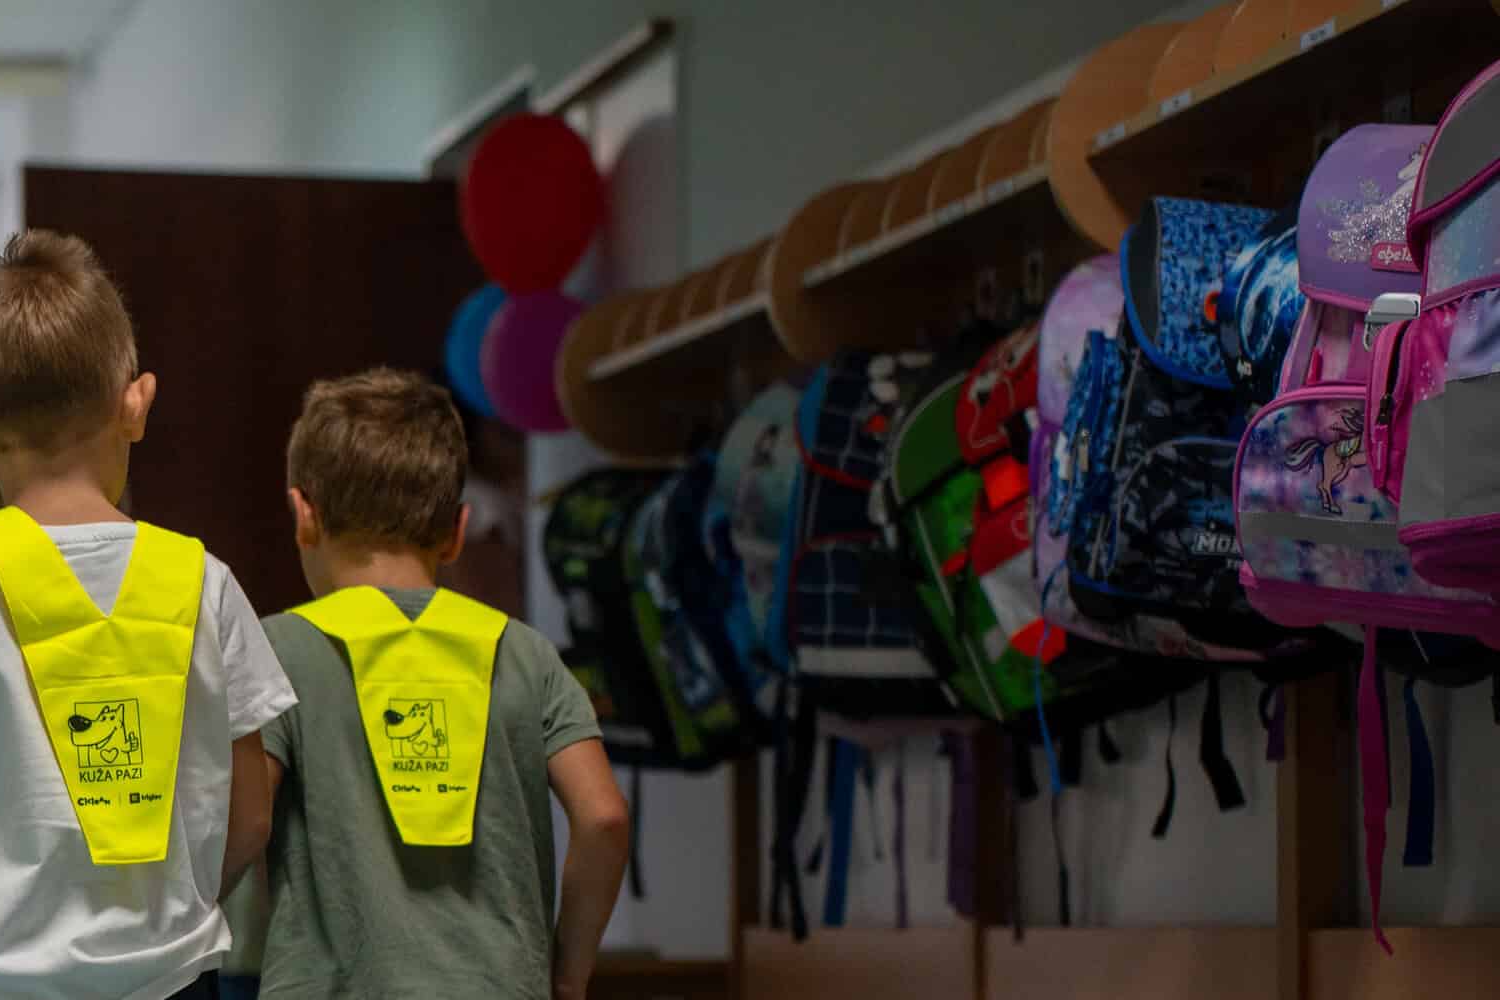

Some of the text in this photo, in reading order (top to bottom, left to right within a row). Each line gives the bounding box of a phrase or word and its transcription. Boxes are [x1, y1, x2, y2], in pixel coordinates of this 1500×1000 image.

[426, 761, 449, 772] PAZI
[79, 768, 142, 783] KUŽA PAZI
